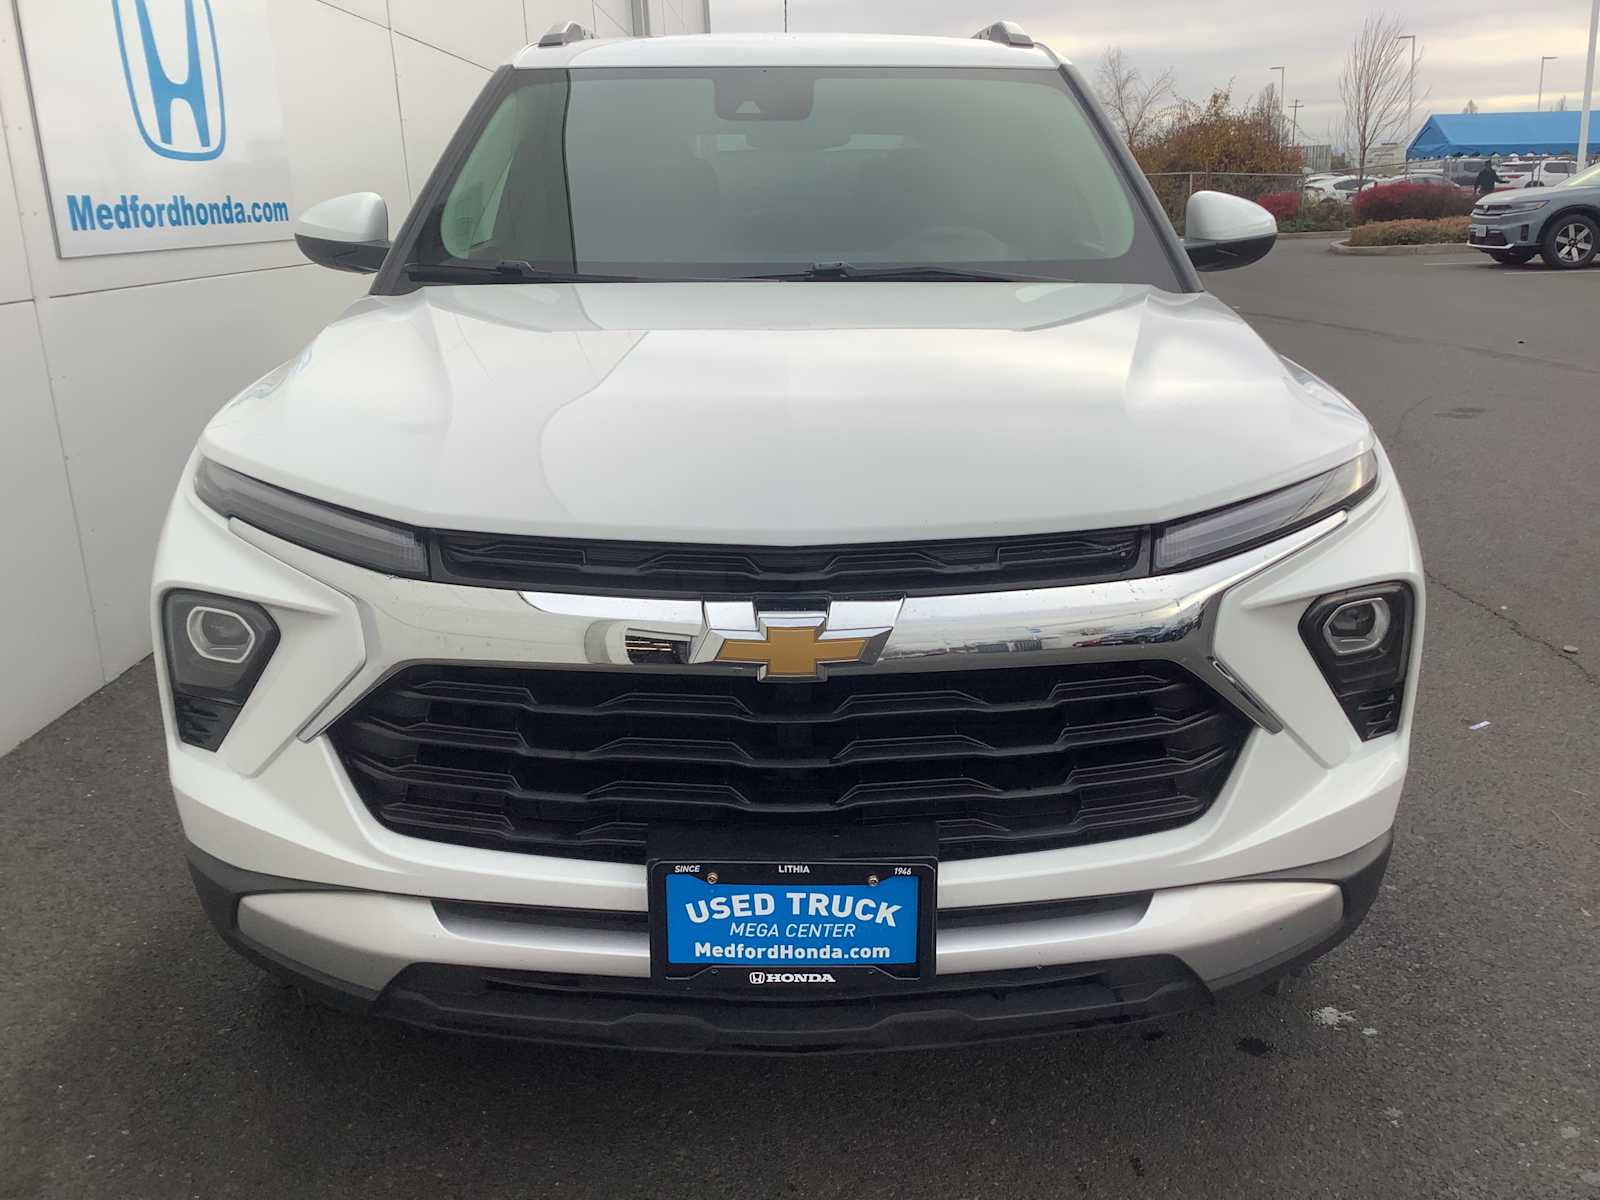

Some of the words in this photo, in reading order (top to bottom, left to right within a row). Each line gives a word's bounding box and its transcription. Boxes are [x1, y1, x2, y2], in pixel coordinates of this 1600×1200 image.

[66, 194, 289, 231] Medfordhonda.com
[674, 865, 700, 873] SINCE
[778, 865, 810, 874] LITHIA
[894, 867, 912, 875] 1946
[686, 893, 775, 923] USED
[786, 892, 902, 927] TRUCK
[729, 922, 780, 937] MEGA
[785, 923, 856, 938] CENTER
[694, 942, 890, 960] MedfordHonda.com
[766, 973, 836, 984] HONDA
